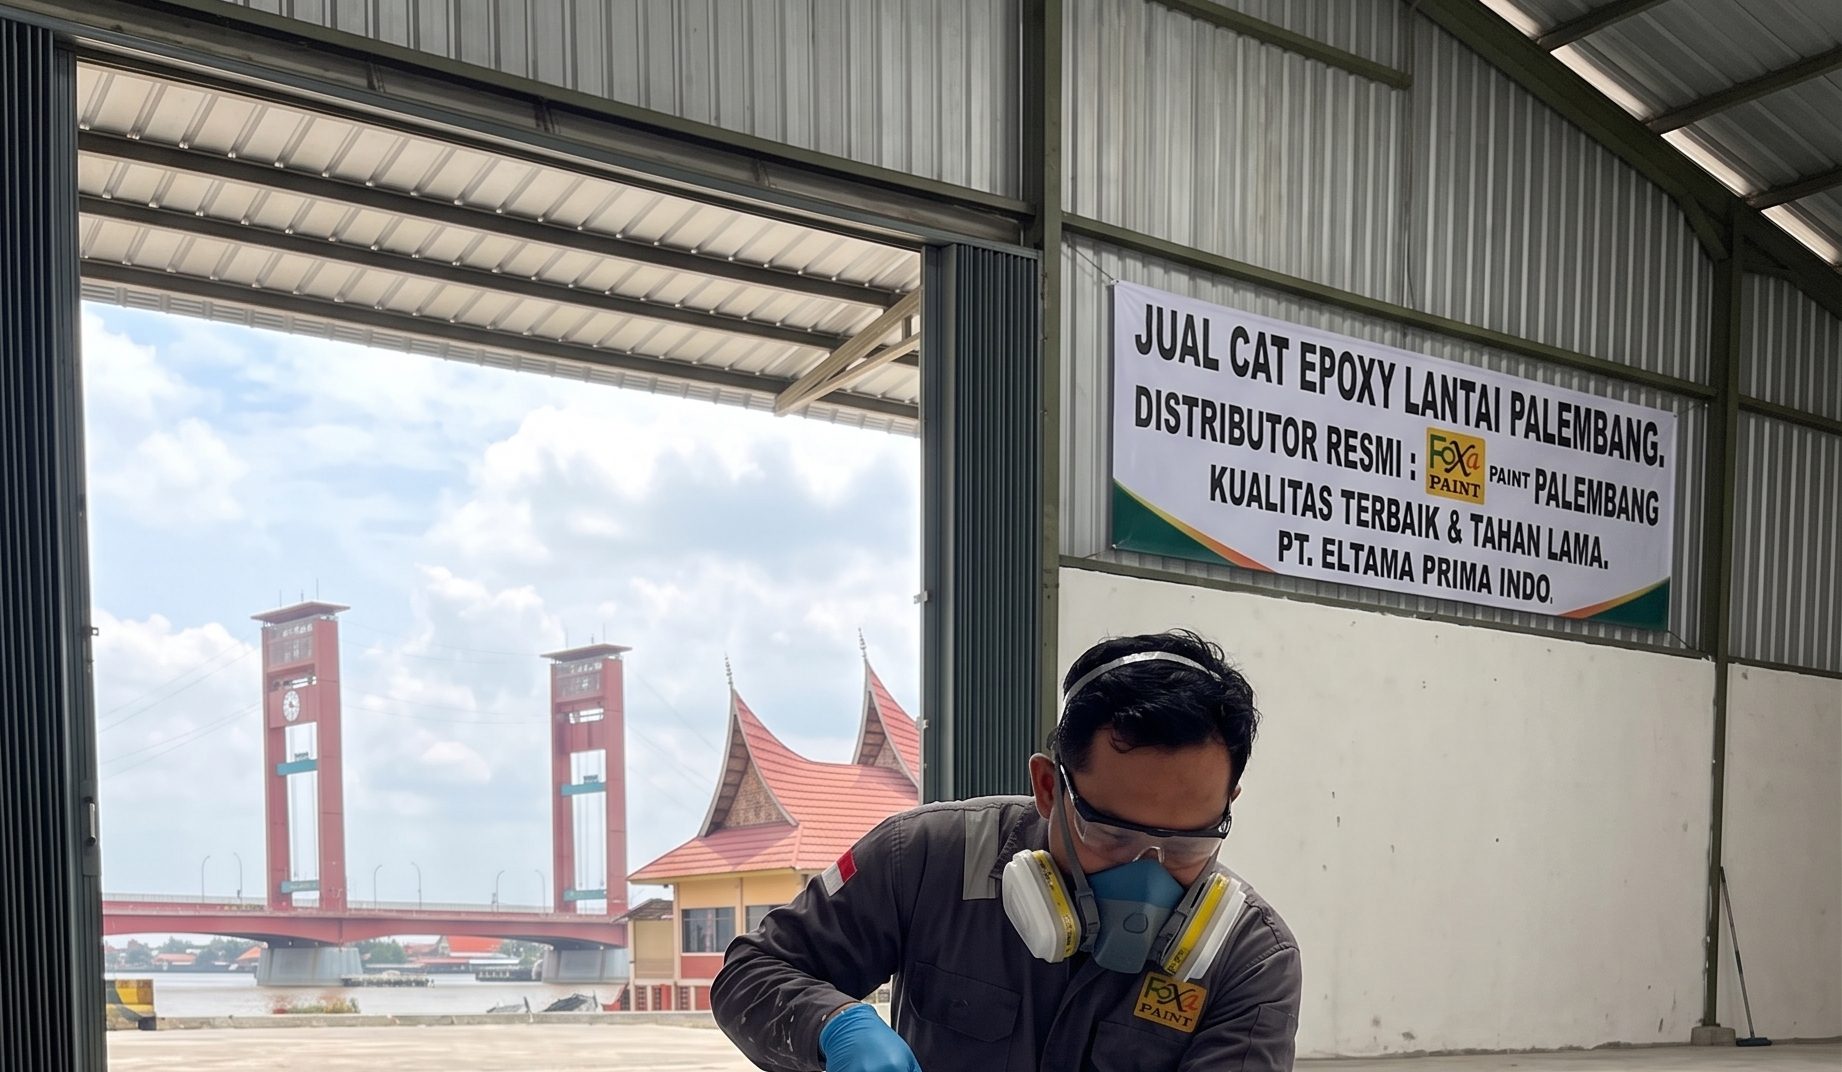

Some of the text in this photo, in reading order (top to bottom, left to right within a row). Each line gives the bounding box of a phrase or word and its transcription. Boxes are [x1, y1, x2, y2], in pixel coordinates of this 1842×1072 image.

[1135, 304, 1665, 468] JUAL CAT EPOXY LANTAI PALEMBANG.
[1135, 385, 1318, 462] DISTRIBUTOR
[1327, 425, 1401, 478] RESMI
[1210, 464, 1609, 570] KUALITAS TERBAIK & TAHAN LAMA.
[1429, 474, 1481, 498] PAINT
[1490, 465, 1659, 526] PAINT PALEMBANG
[1278, 530, 1313, 566] PT.
[1321, 537, 1415, 583] ELTAMA
[1422, 554, 1492, 595] PRIMA
[1139, 1003, 1193, 1027] PAINT
